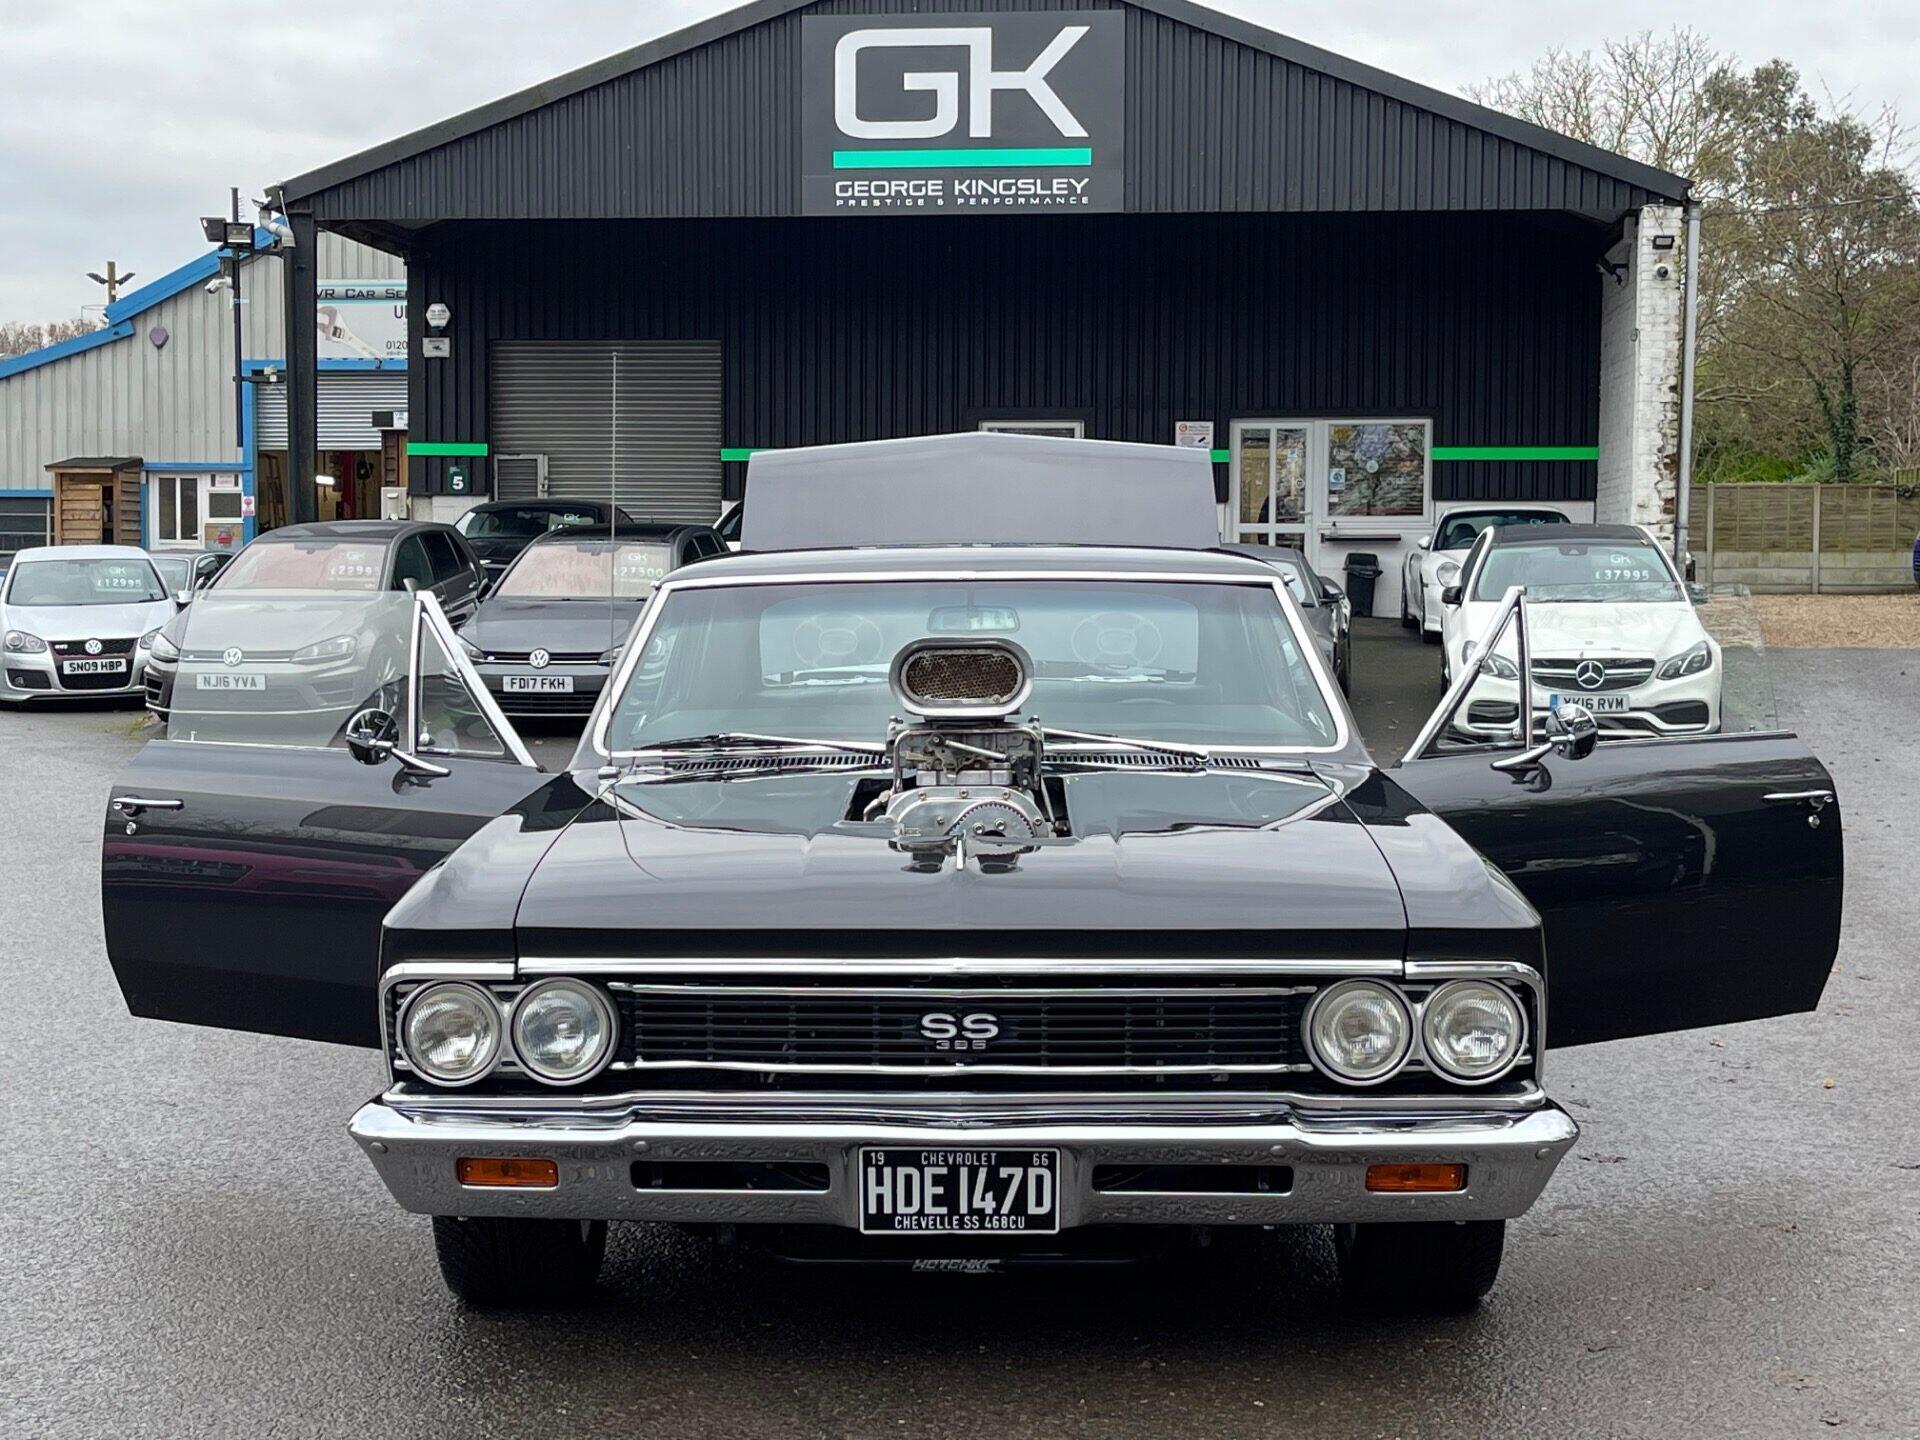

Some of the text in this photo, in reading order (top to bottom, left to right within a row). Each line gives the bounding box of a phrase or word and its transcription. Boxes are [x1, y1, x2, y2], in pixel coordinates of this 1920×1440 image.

[835, 26, 1091, 139] GK
[835, 178, 1090, 197] GEORGE KINGSLEY
[836, 199, 925, 207] PRESTIGE
[957, 197, 1089, 206] PERFORMANCE
[452, 476, 464, 490] 5
[1610, 553, 1631, 565] GK
[69, 660, 122, 673] SN09 HBP
[203, 676, 257, 688] NJ16 YVA
[510, 677, 565, 690] FD17 FKH
[920, 1013, 999, 1039] SS
[870, 1152, 1049, 1166] 19 CHEVROLET 66
[867, 1166, 1052, 1215] HDE 147D
[894, 1216, 1025, 1230] CHEVELLE SS 468CU
